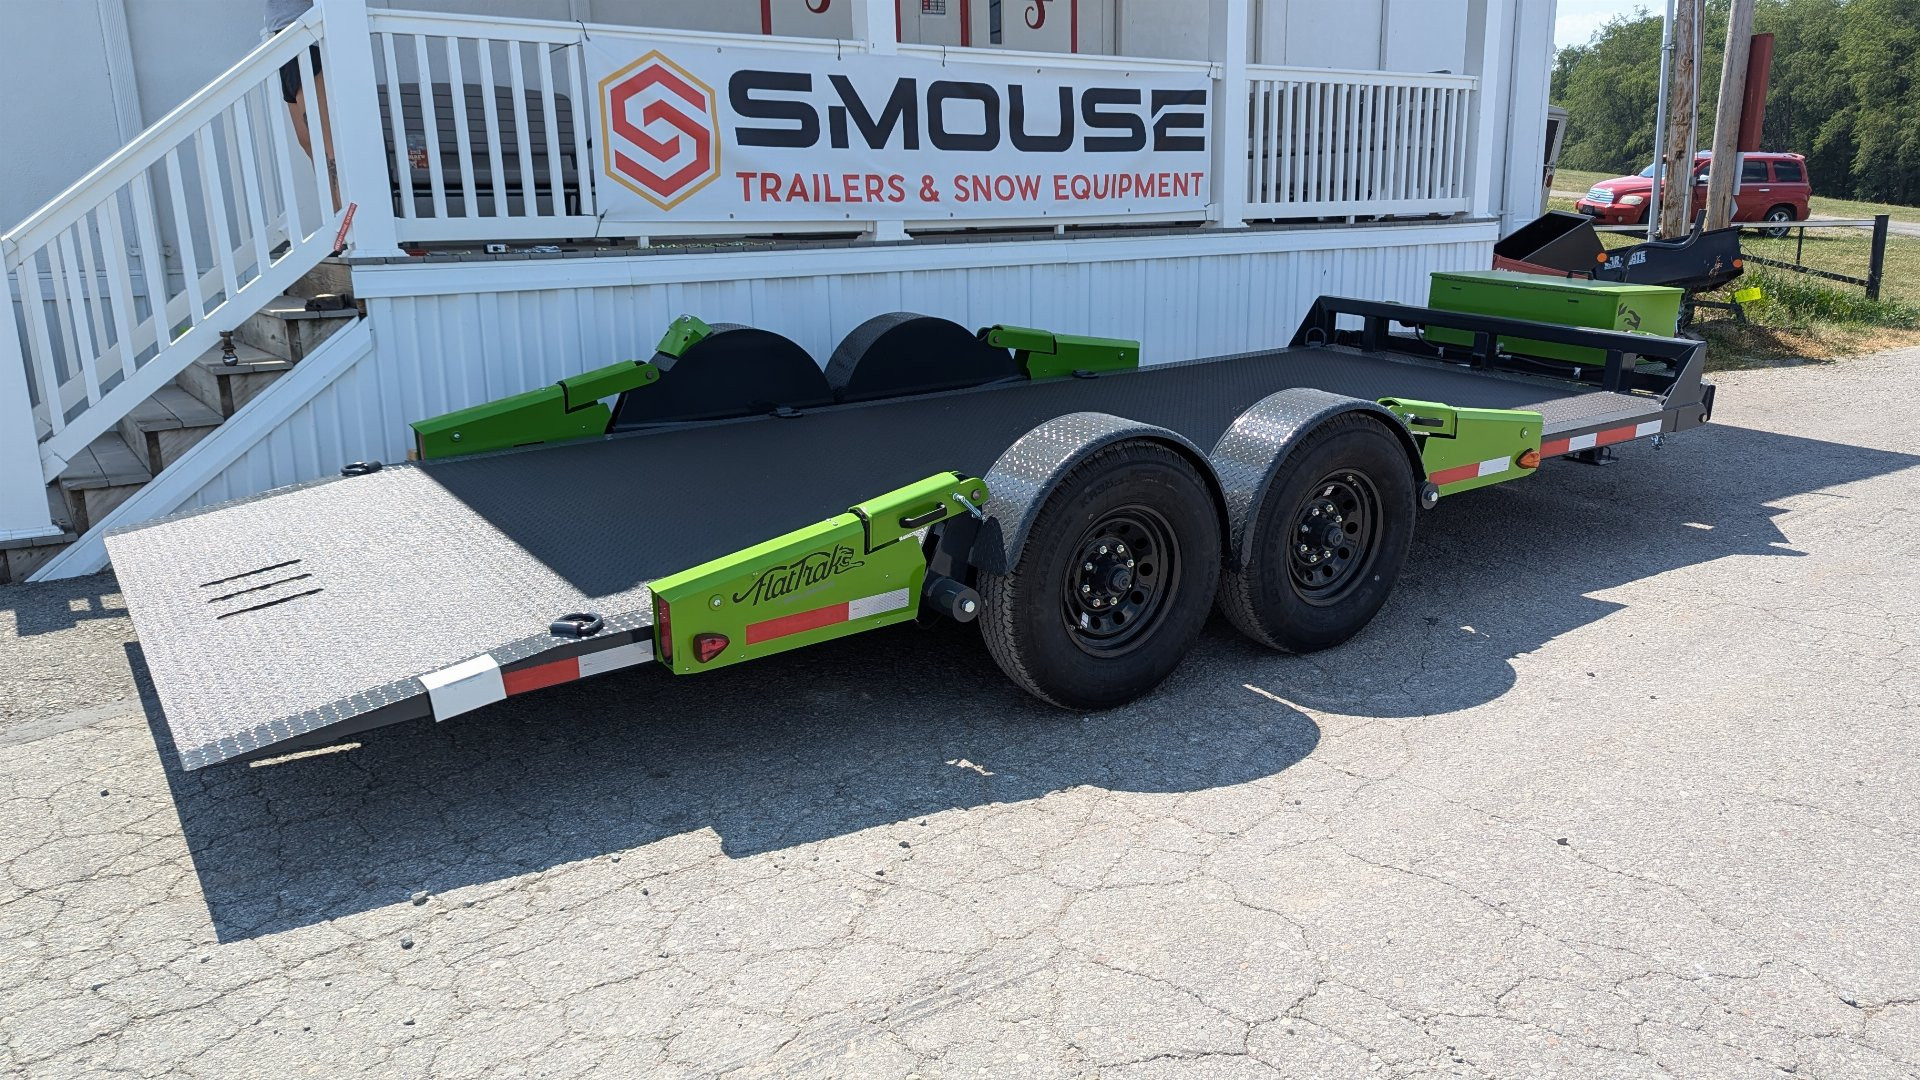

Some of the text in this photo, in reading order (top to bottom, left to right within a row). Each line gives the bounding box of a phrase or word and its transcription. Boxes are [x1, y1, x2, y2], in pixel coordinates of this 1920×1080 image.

[728, 69, 1207, 153] SMOUSE
[736, 172, 1203, 202] TRAILERS & SNOW EQUIPMENT
